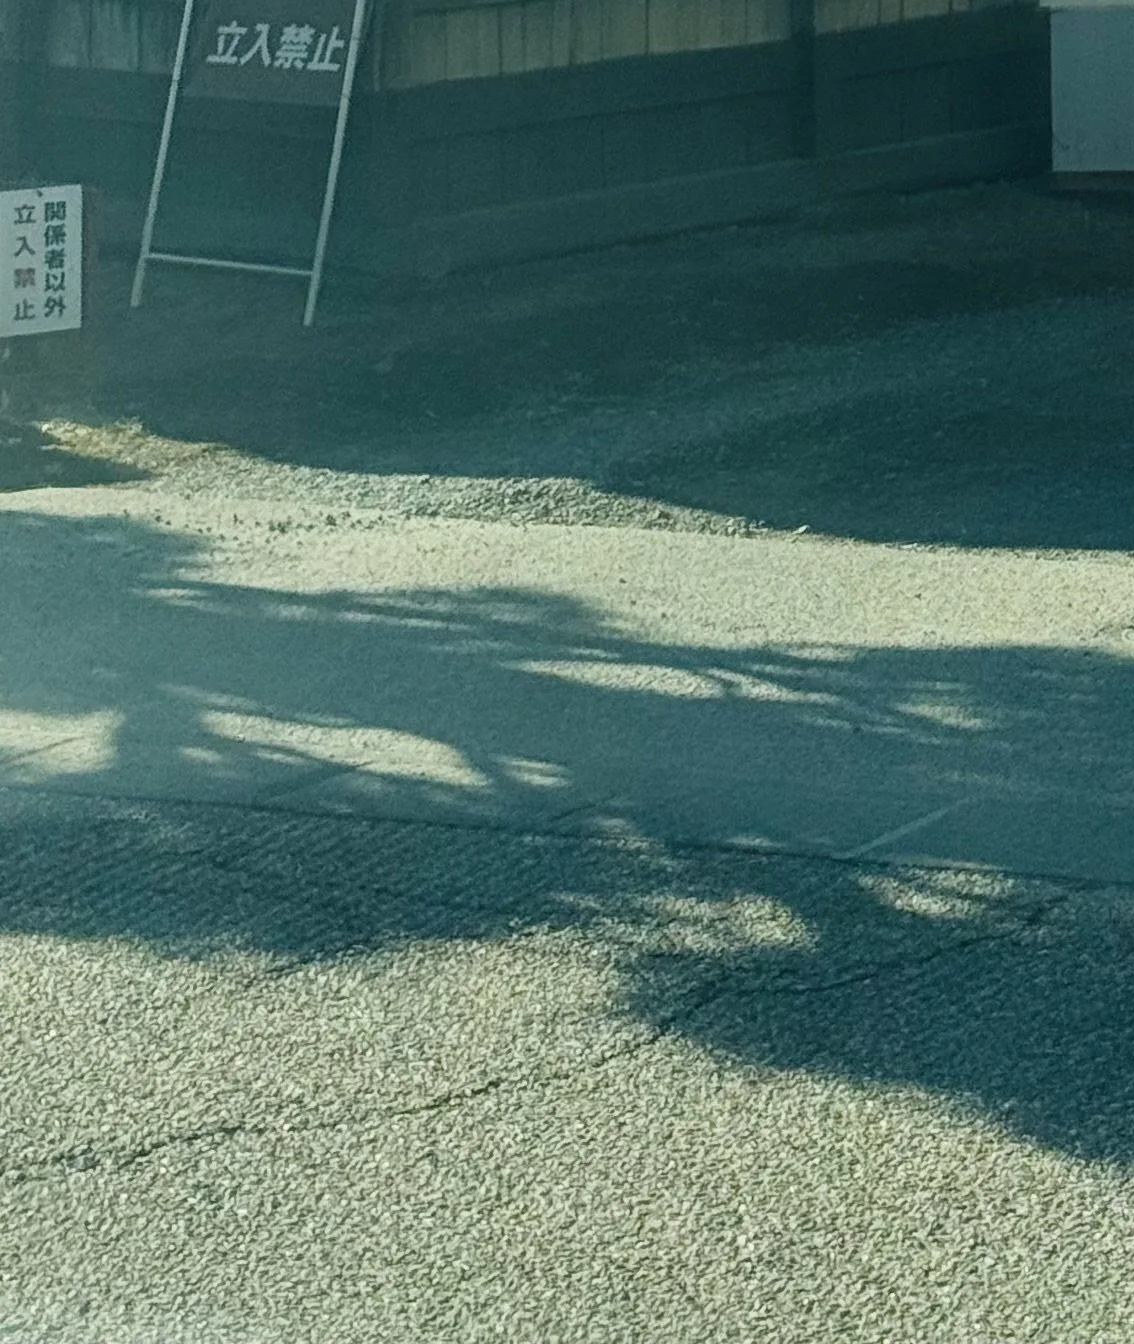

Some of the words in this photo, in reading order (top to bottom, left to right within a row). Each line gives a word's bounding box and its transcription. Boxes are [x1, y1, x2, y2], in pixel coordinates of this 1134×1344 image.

[206, 21, 345, 72] 立入禁止
[14, 204, 36, 321] 立入禁止
[44, 201, 66, 318] 関係者以外
